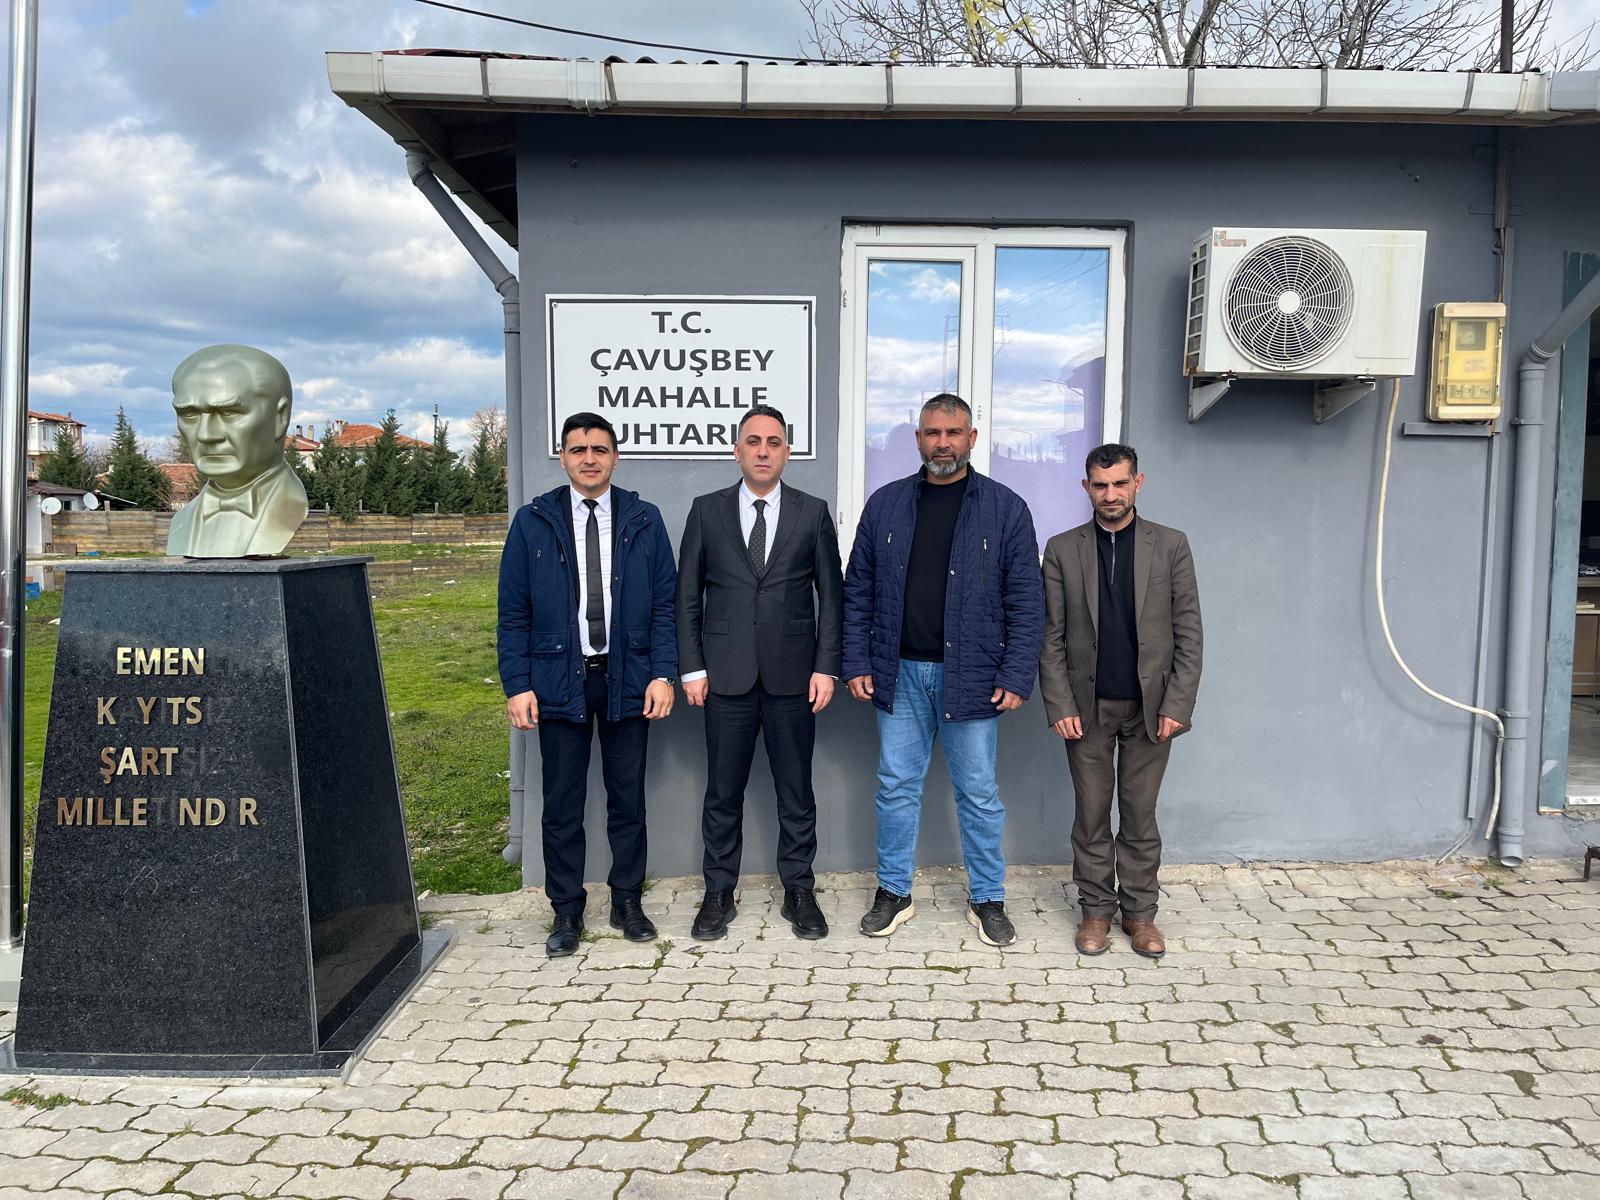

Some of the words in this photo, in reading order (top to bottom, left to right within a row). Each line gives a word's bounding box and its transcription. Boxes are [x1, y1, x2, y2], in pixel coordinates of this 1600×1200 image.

[651, 311, 712, 334] T.C.
[590, 348, 775, 378] ÇAVUŞBEY
[598, 386, 768, 409] MAHALLE
